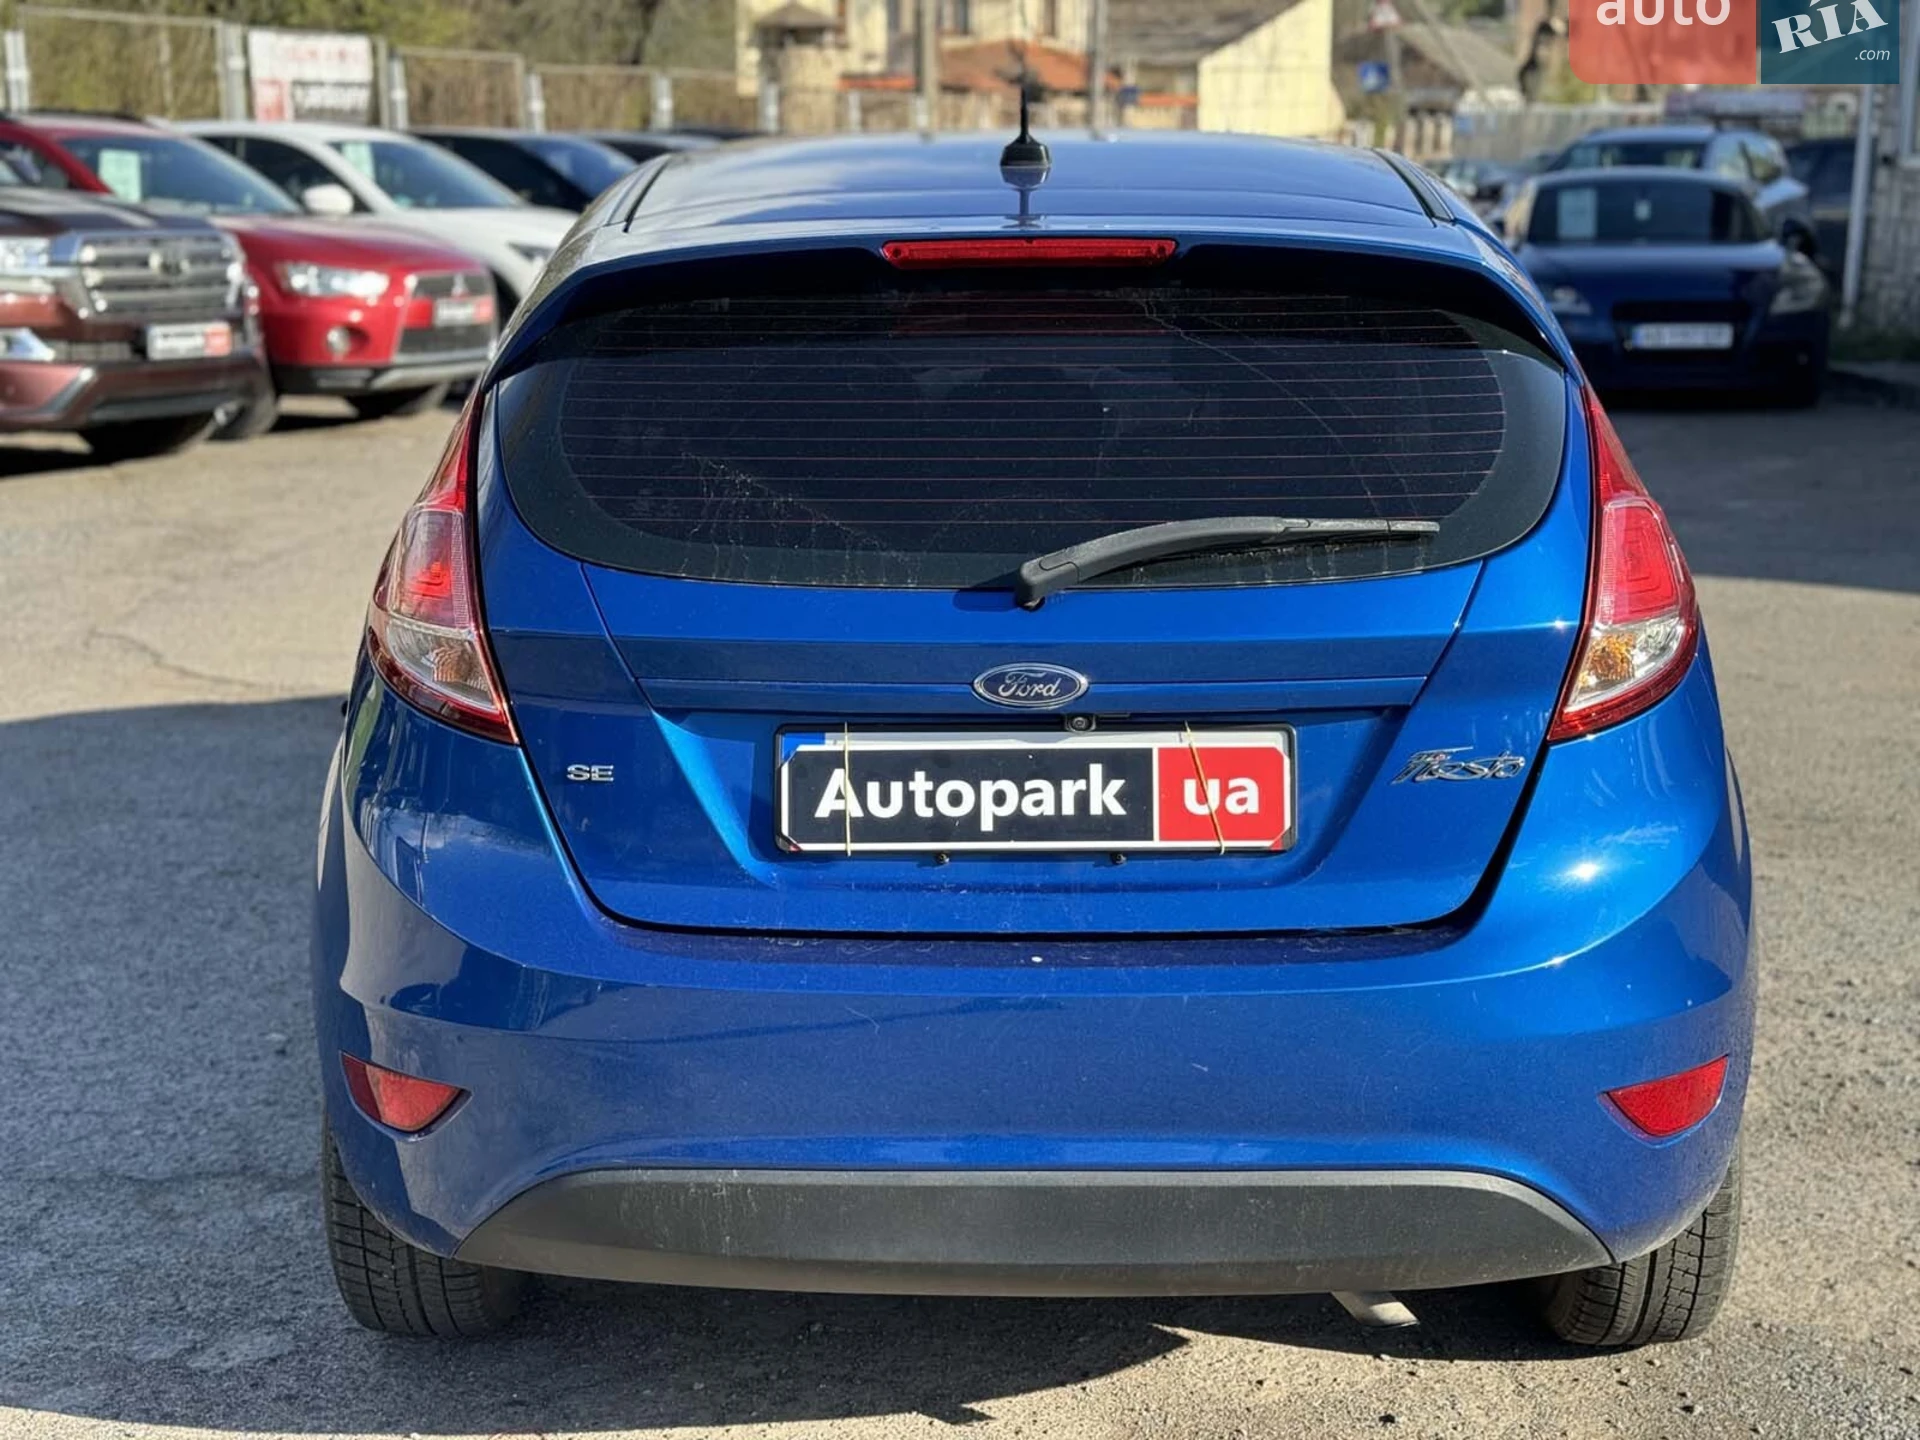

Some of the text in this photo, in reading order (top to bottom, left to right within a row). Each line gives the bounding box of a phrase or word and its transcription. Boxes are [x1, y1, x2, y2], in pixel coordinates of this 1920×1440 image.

[998, 671, 1062, 697] Ford
[566, 764, 615, 781] SE
[1390, 746, 1526, 785] Fiesta
[814, 763, 1260, 832] Autopark ua
